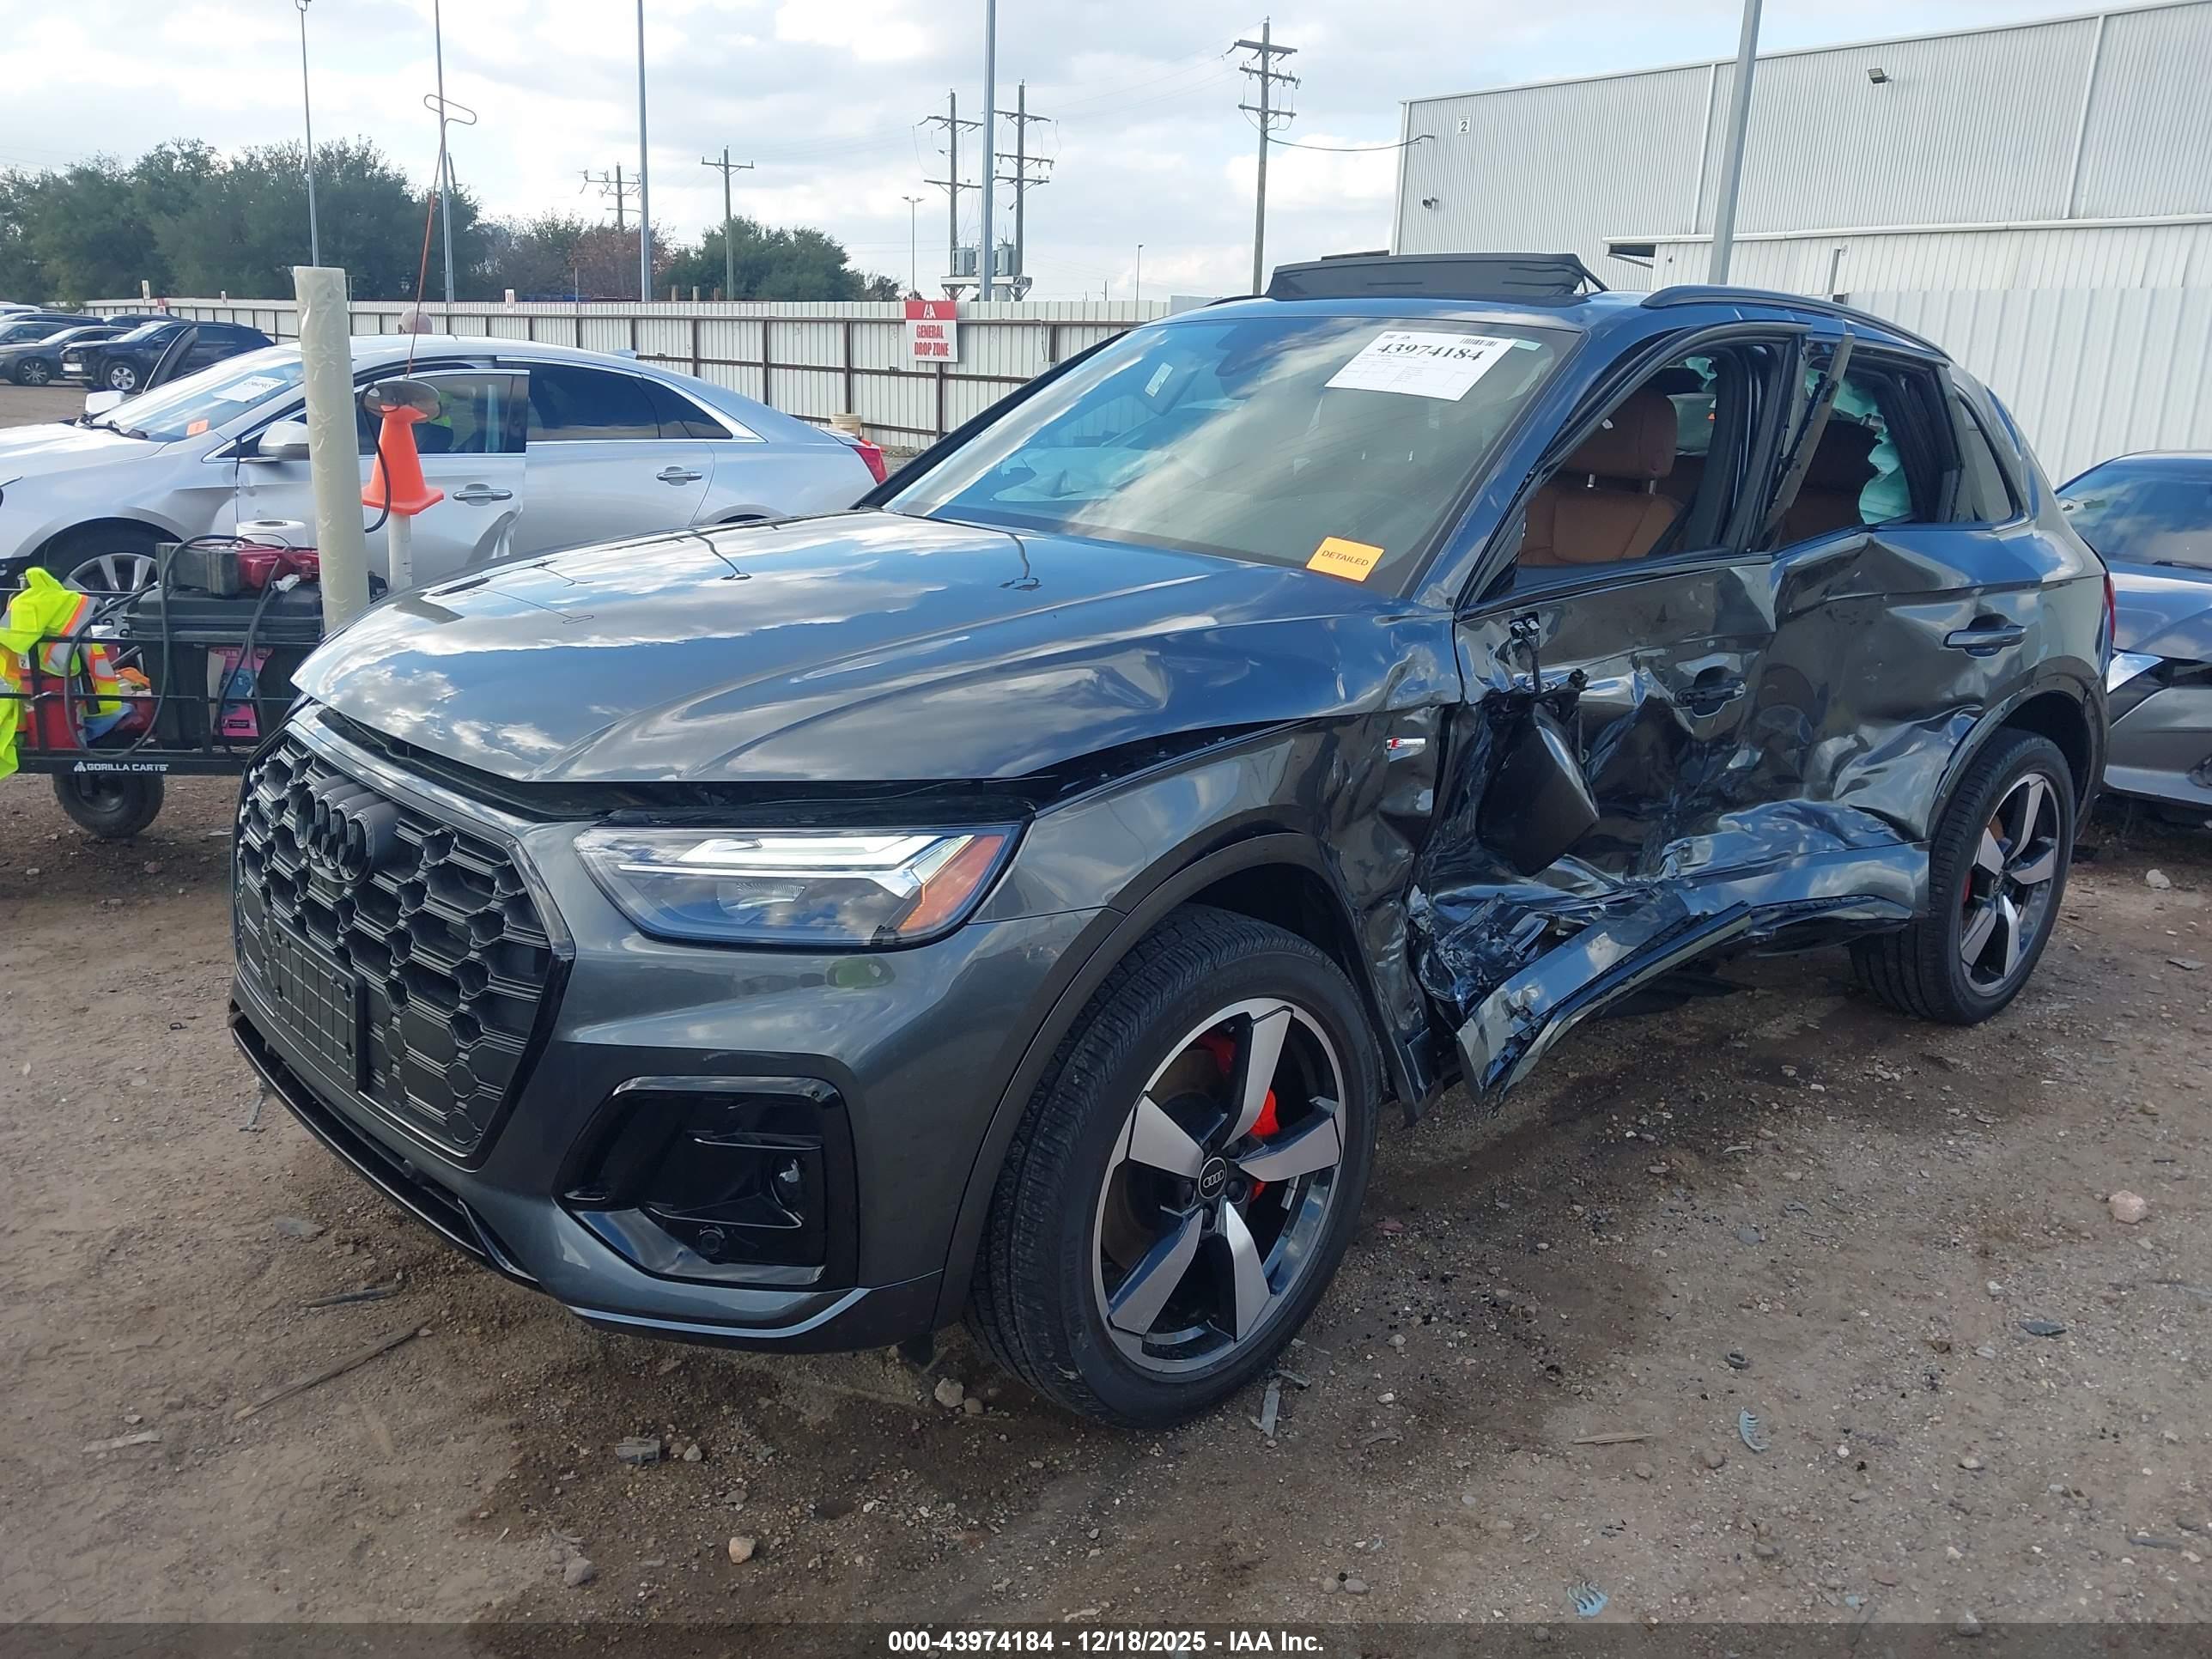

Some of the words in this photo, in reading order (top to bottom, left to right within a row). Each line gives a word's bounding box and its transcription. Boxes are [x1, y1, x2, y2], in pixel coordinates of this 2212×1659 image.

[1461, 121, 1468, 132] 2
[916, 325, 944, 338] GENERAL
[915, 342, 933, 356] DROP
[933, 342, 949, 356] ZONE
[1376, 343, 1486, 362] 43974184
[1322, 550, 1369, 566] DETAILED
[87, 763, 130, 772] GORILLA
[132, 763, 167, 772] CARTS
